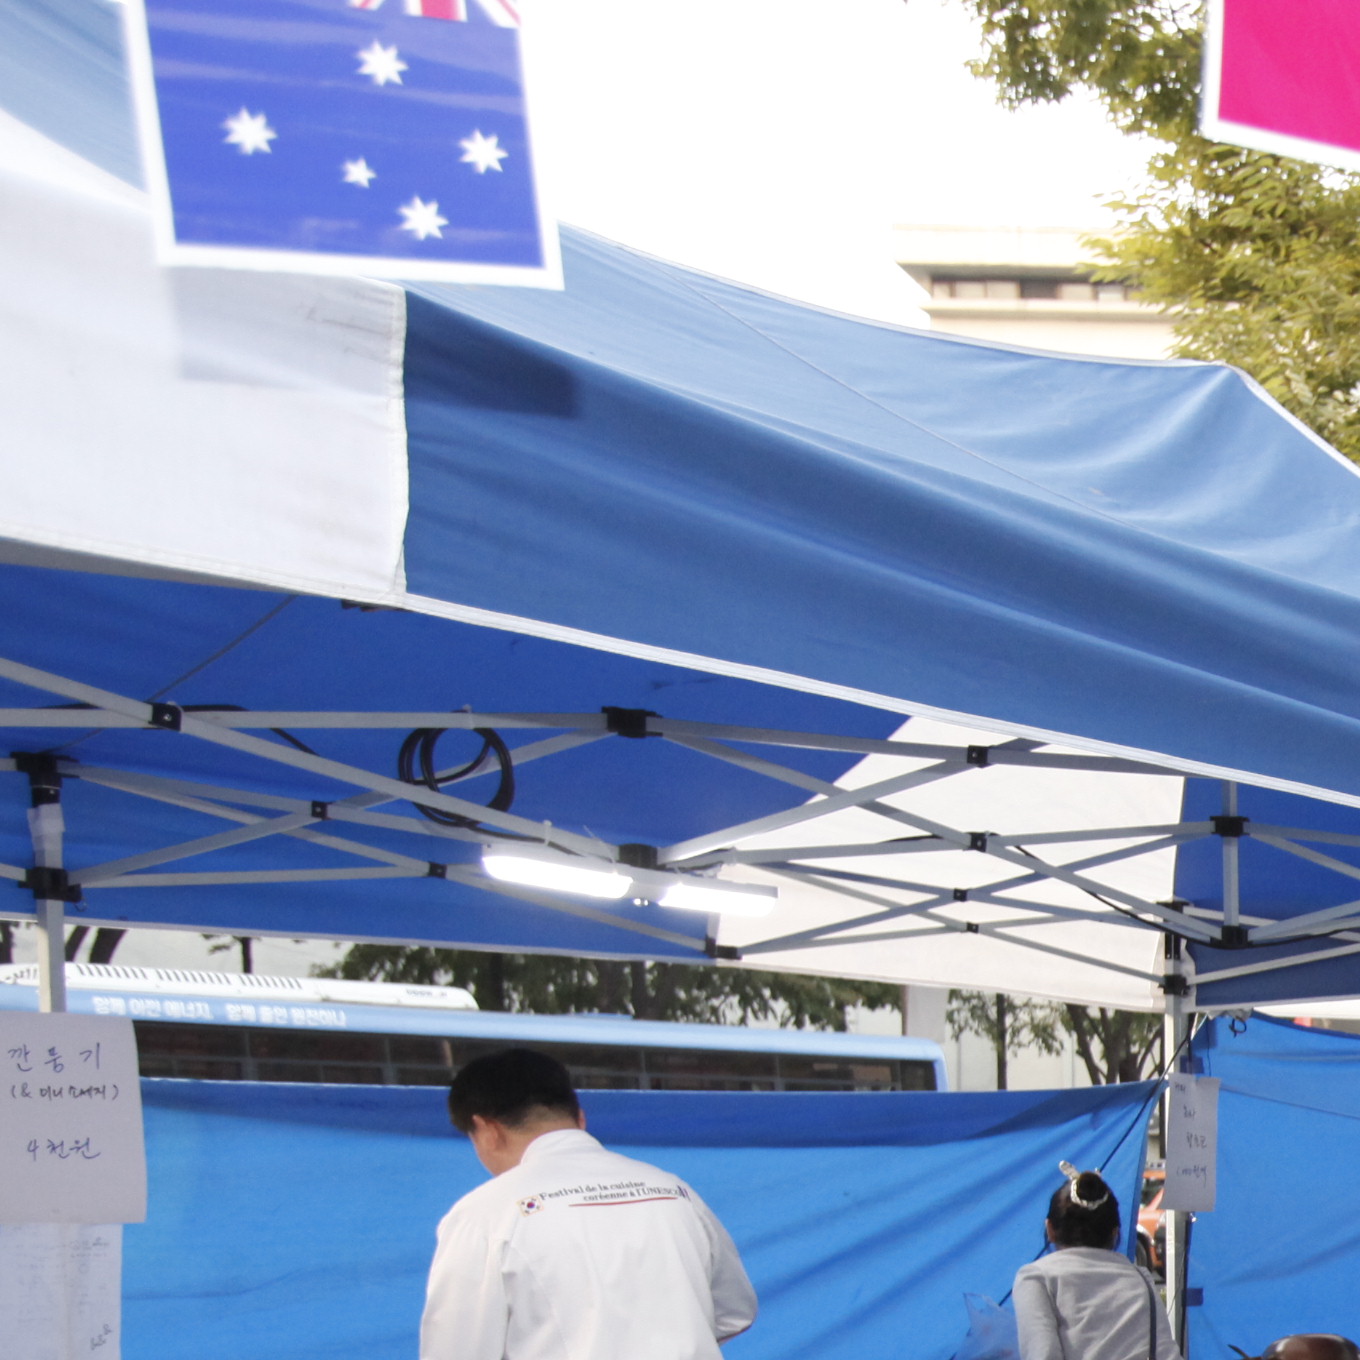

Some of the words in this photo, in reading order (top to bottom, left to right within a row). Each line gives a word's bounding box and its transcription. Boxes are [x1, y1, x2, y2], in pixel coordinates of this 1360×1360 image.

[8, 1044, 101, 1073] 깐풍기
[27, 1138, 101, 1161] 4천원
[539, 1186, 584, 1201] Festival
[585, 1184, 596, 1193] de
[599, 1183, 609, 1191] la
